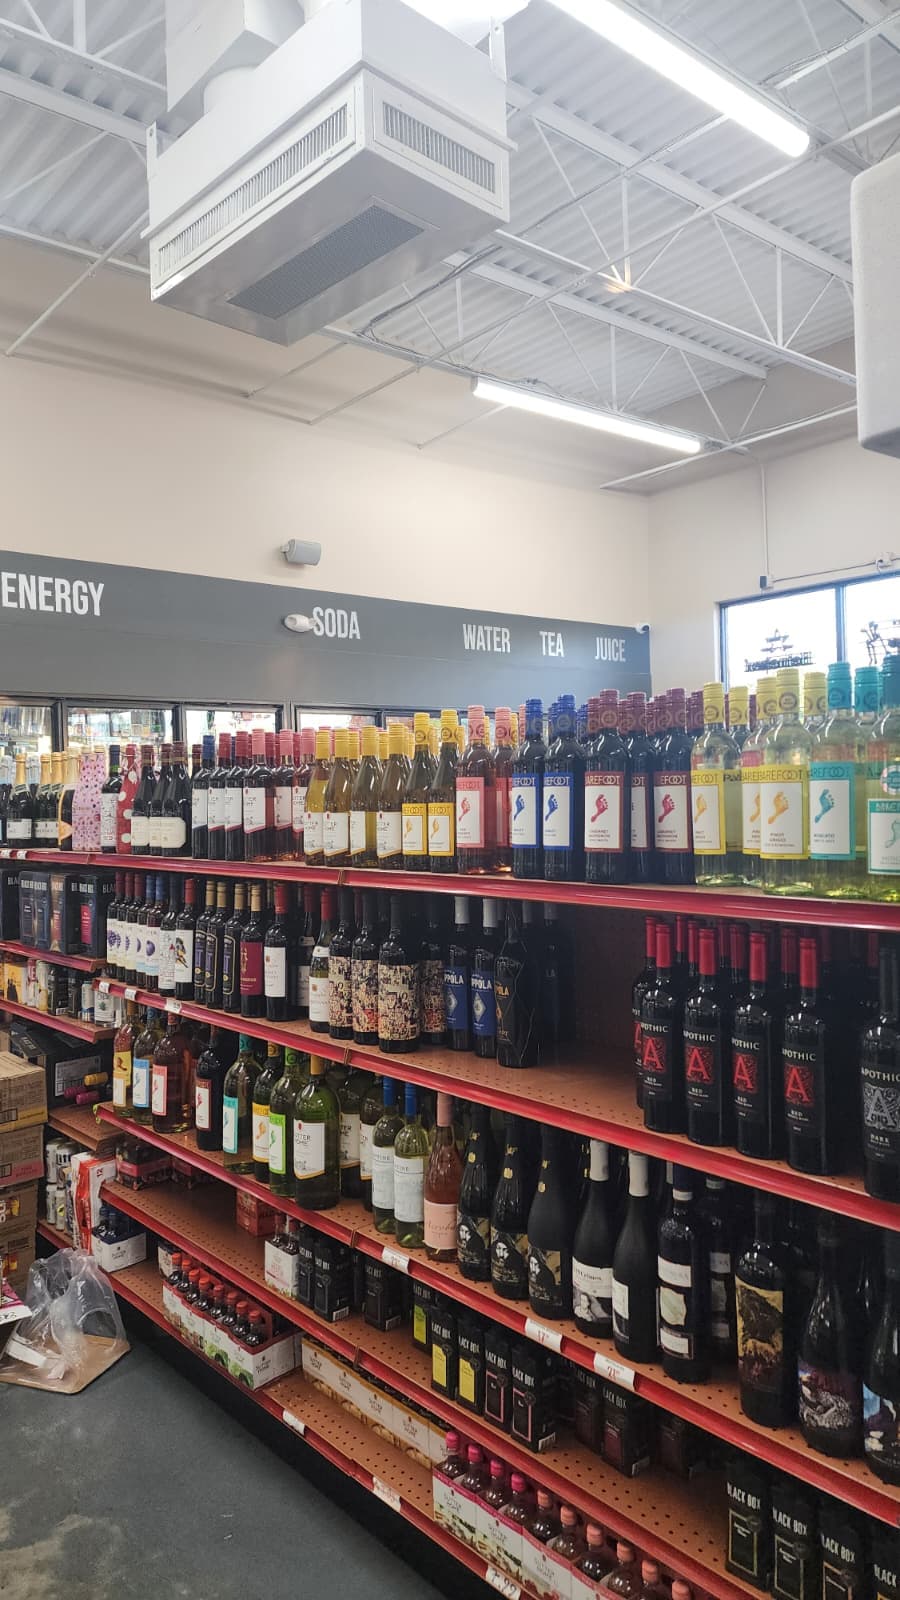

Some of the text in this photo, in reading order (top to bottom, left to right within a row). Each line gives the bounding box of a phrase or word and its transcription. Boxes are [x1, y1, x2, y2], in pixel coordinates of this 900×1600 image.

[1, 572, 104, 616] ENERGY
[312, 606, 361, 640] SODA
[462, 623, 511, 653] WATER
[540, 631, 564, 658] TEA
[595, 637, 626, 663] JUICE
[643, 1038, 664, 1070] A
[687, 1048, 711, 1081] A
[734, 1056, 754, 1089] A
[786, 1067, 811, 1102] A
[747, 1493, 761, 1510] BOX
[793, 1520, 808, 1537] BOX
[841, 1546, 856, 1564] BOX
